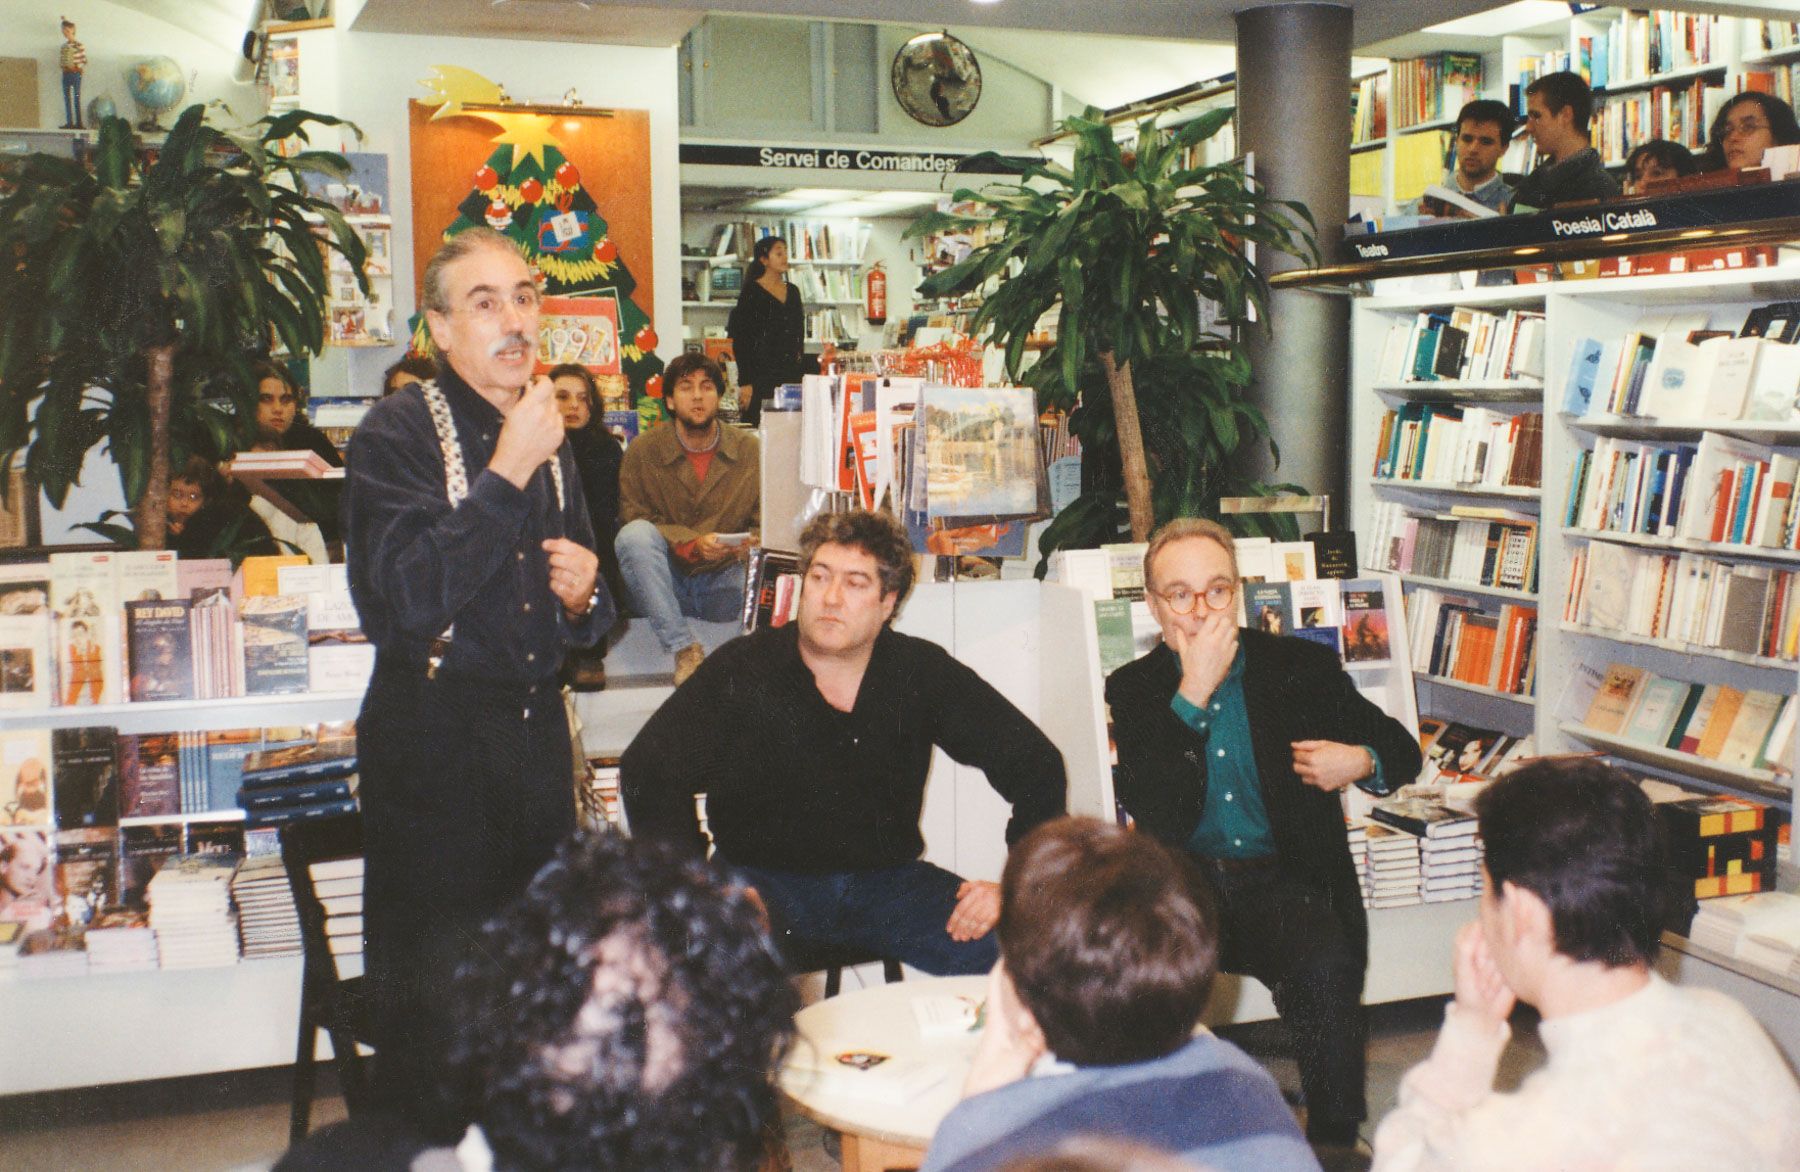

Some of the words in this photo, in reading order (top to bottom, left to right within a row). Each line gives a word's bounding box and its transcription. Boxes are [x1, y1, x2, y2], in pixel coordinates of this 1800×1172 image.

[760, 148, 820, 168] Servei
[825, 151, 850, 169] de
[856, 152, 957, 173] Comandes
[1552, 208, 1657, 236] Poesia/Català
[1355, 243, 1389, 258] Teatre
[541, 327, 607, 361] 1997
